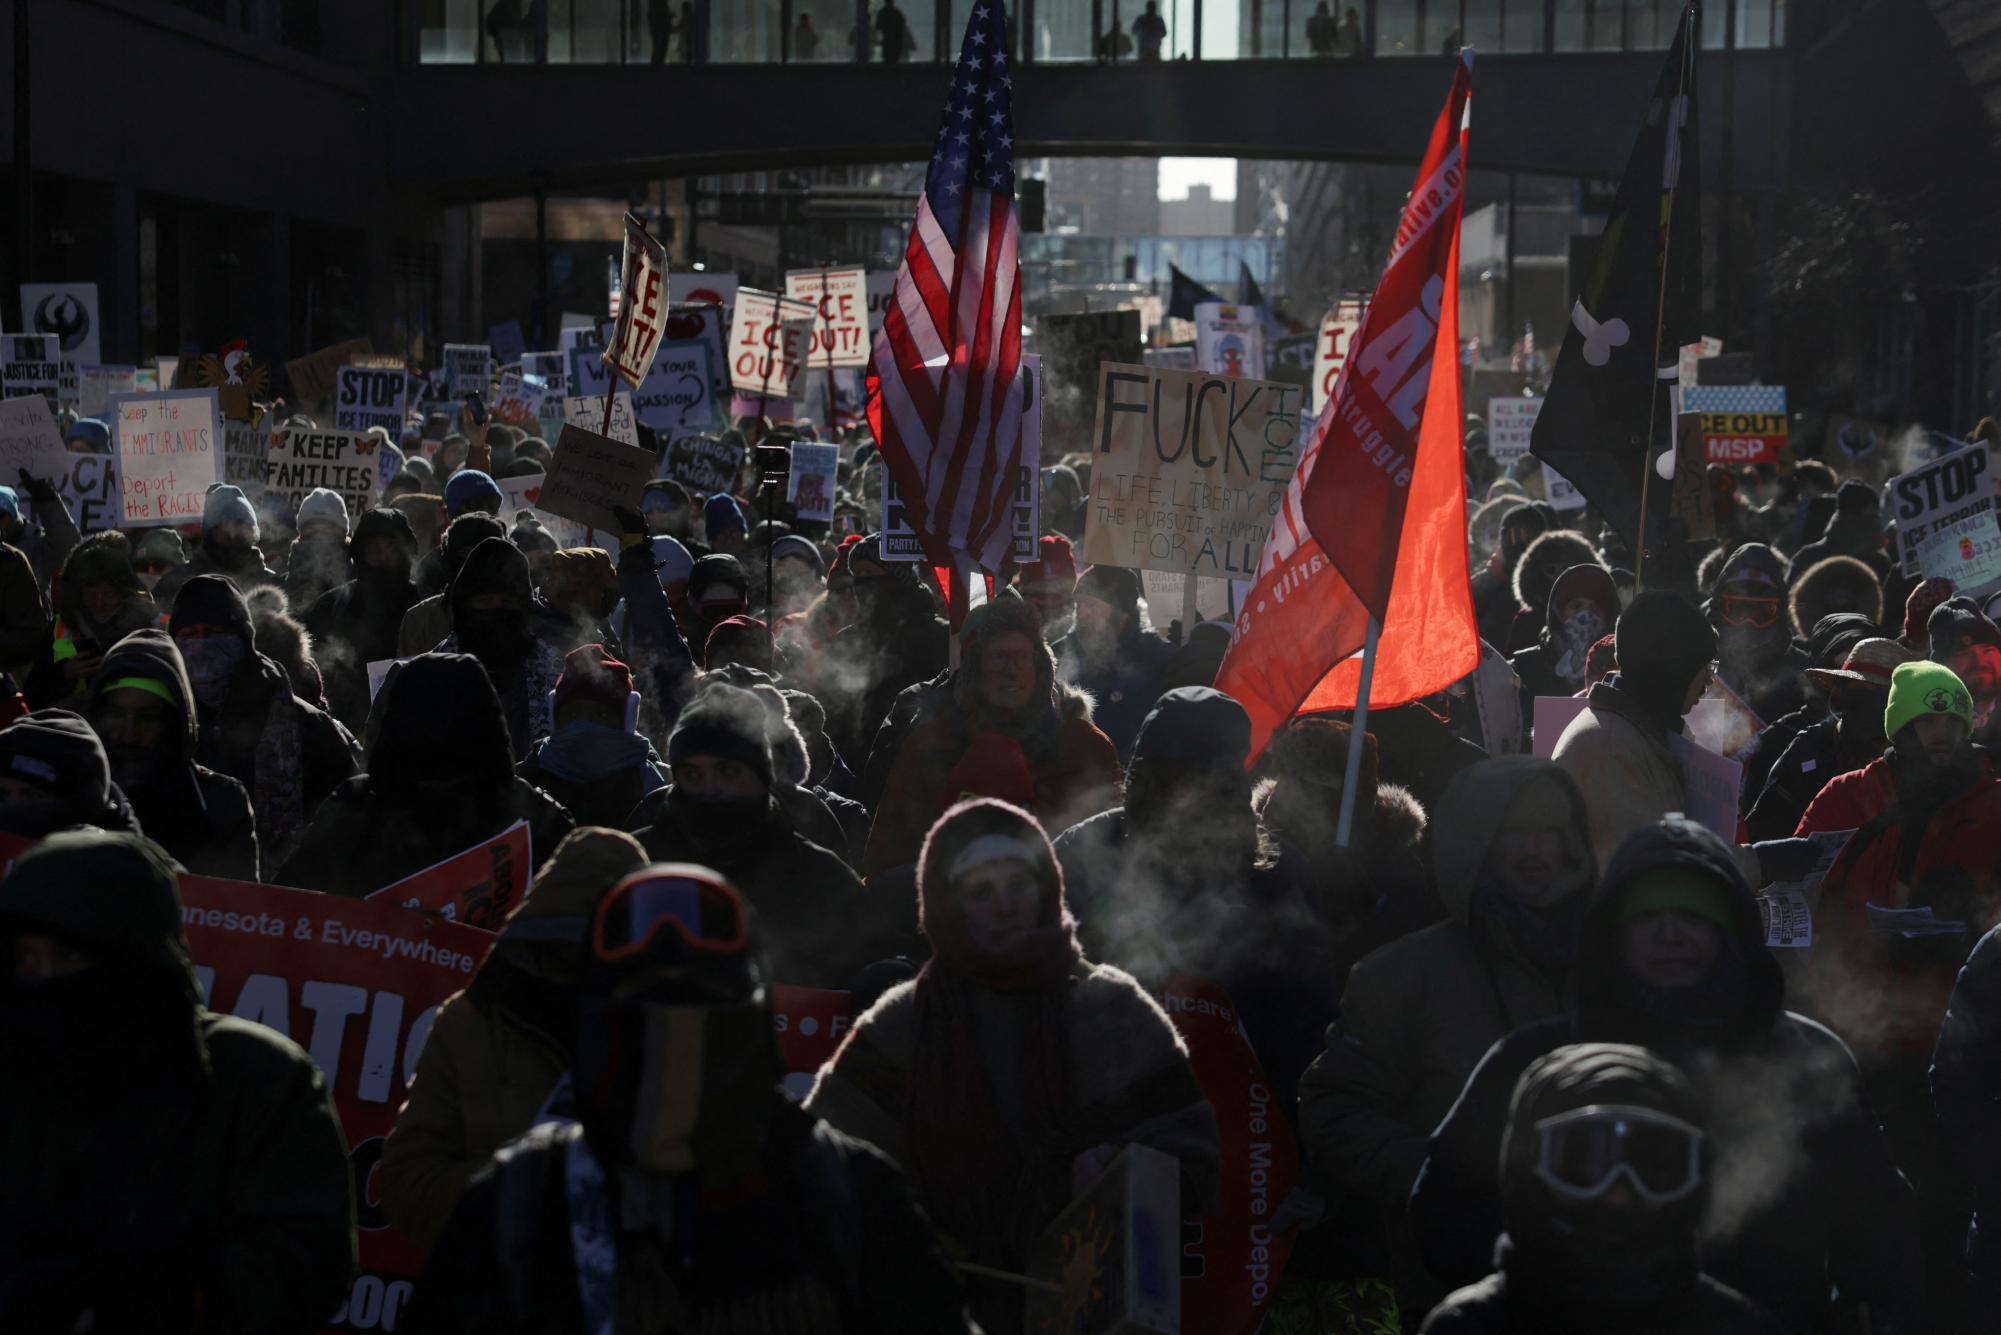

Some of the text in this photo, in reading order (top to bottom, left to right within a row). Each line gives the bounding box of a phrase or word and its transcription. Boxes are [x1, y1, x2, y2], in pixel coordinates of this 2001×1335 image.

[799, 294, 855, 322] CE
[740, 319, 801, 358] ICE
[4, 362, 59, 381] JUSTICE FOR
[660, 359, 697, 373] YOUR
[341, 370, 404, 408] STOP
[119, 398, 180, 424] Keep the
[338, 411, 402, 432] ICE TERROR
[1100, 371, 1263, 477] FUCK
[1732, 414, 1786, 433] OUT
[120, 429, 209, 456] IMMIGRANTS
[226, 430, 268, 452] MANY
[292, 433, 350, 460] KEEP
[679, 438, 734, 466] CHINGA
[1708, 438, 1765, 459] MSP
[265, 461, 373, 491] FAMILIES
[691, 453, 713, 472] LA
[120, 471, 177, 495] Deport
[1097, 473, 1162, 504] LIFE
[1172, 478, 1256, 513] LIBERTY
[1896, 447, 1987, 520] STOP
[125, 499, 150, 518] the
[1096, 506, 1125, 526] THE
[1136, 509, 1205, 535] PURSUIT
[888, 538, 914, 551] PARTY
[1903, 524, 1928, 547] ICE
[1132, 531, 1257, 574] FOR ALL
[1782, 903, 1792, 940] STRIKE
[292, 917, 314, 941] &
[321, 922, 476, 974] Everywhere
[1249, 1081, 1271, 1135] One
[1249, 1142, 1272, 1216] More
